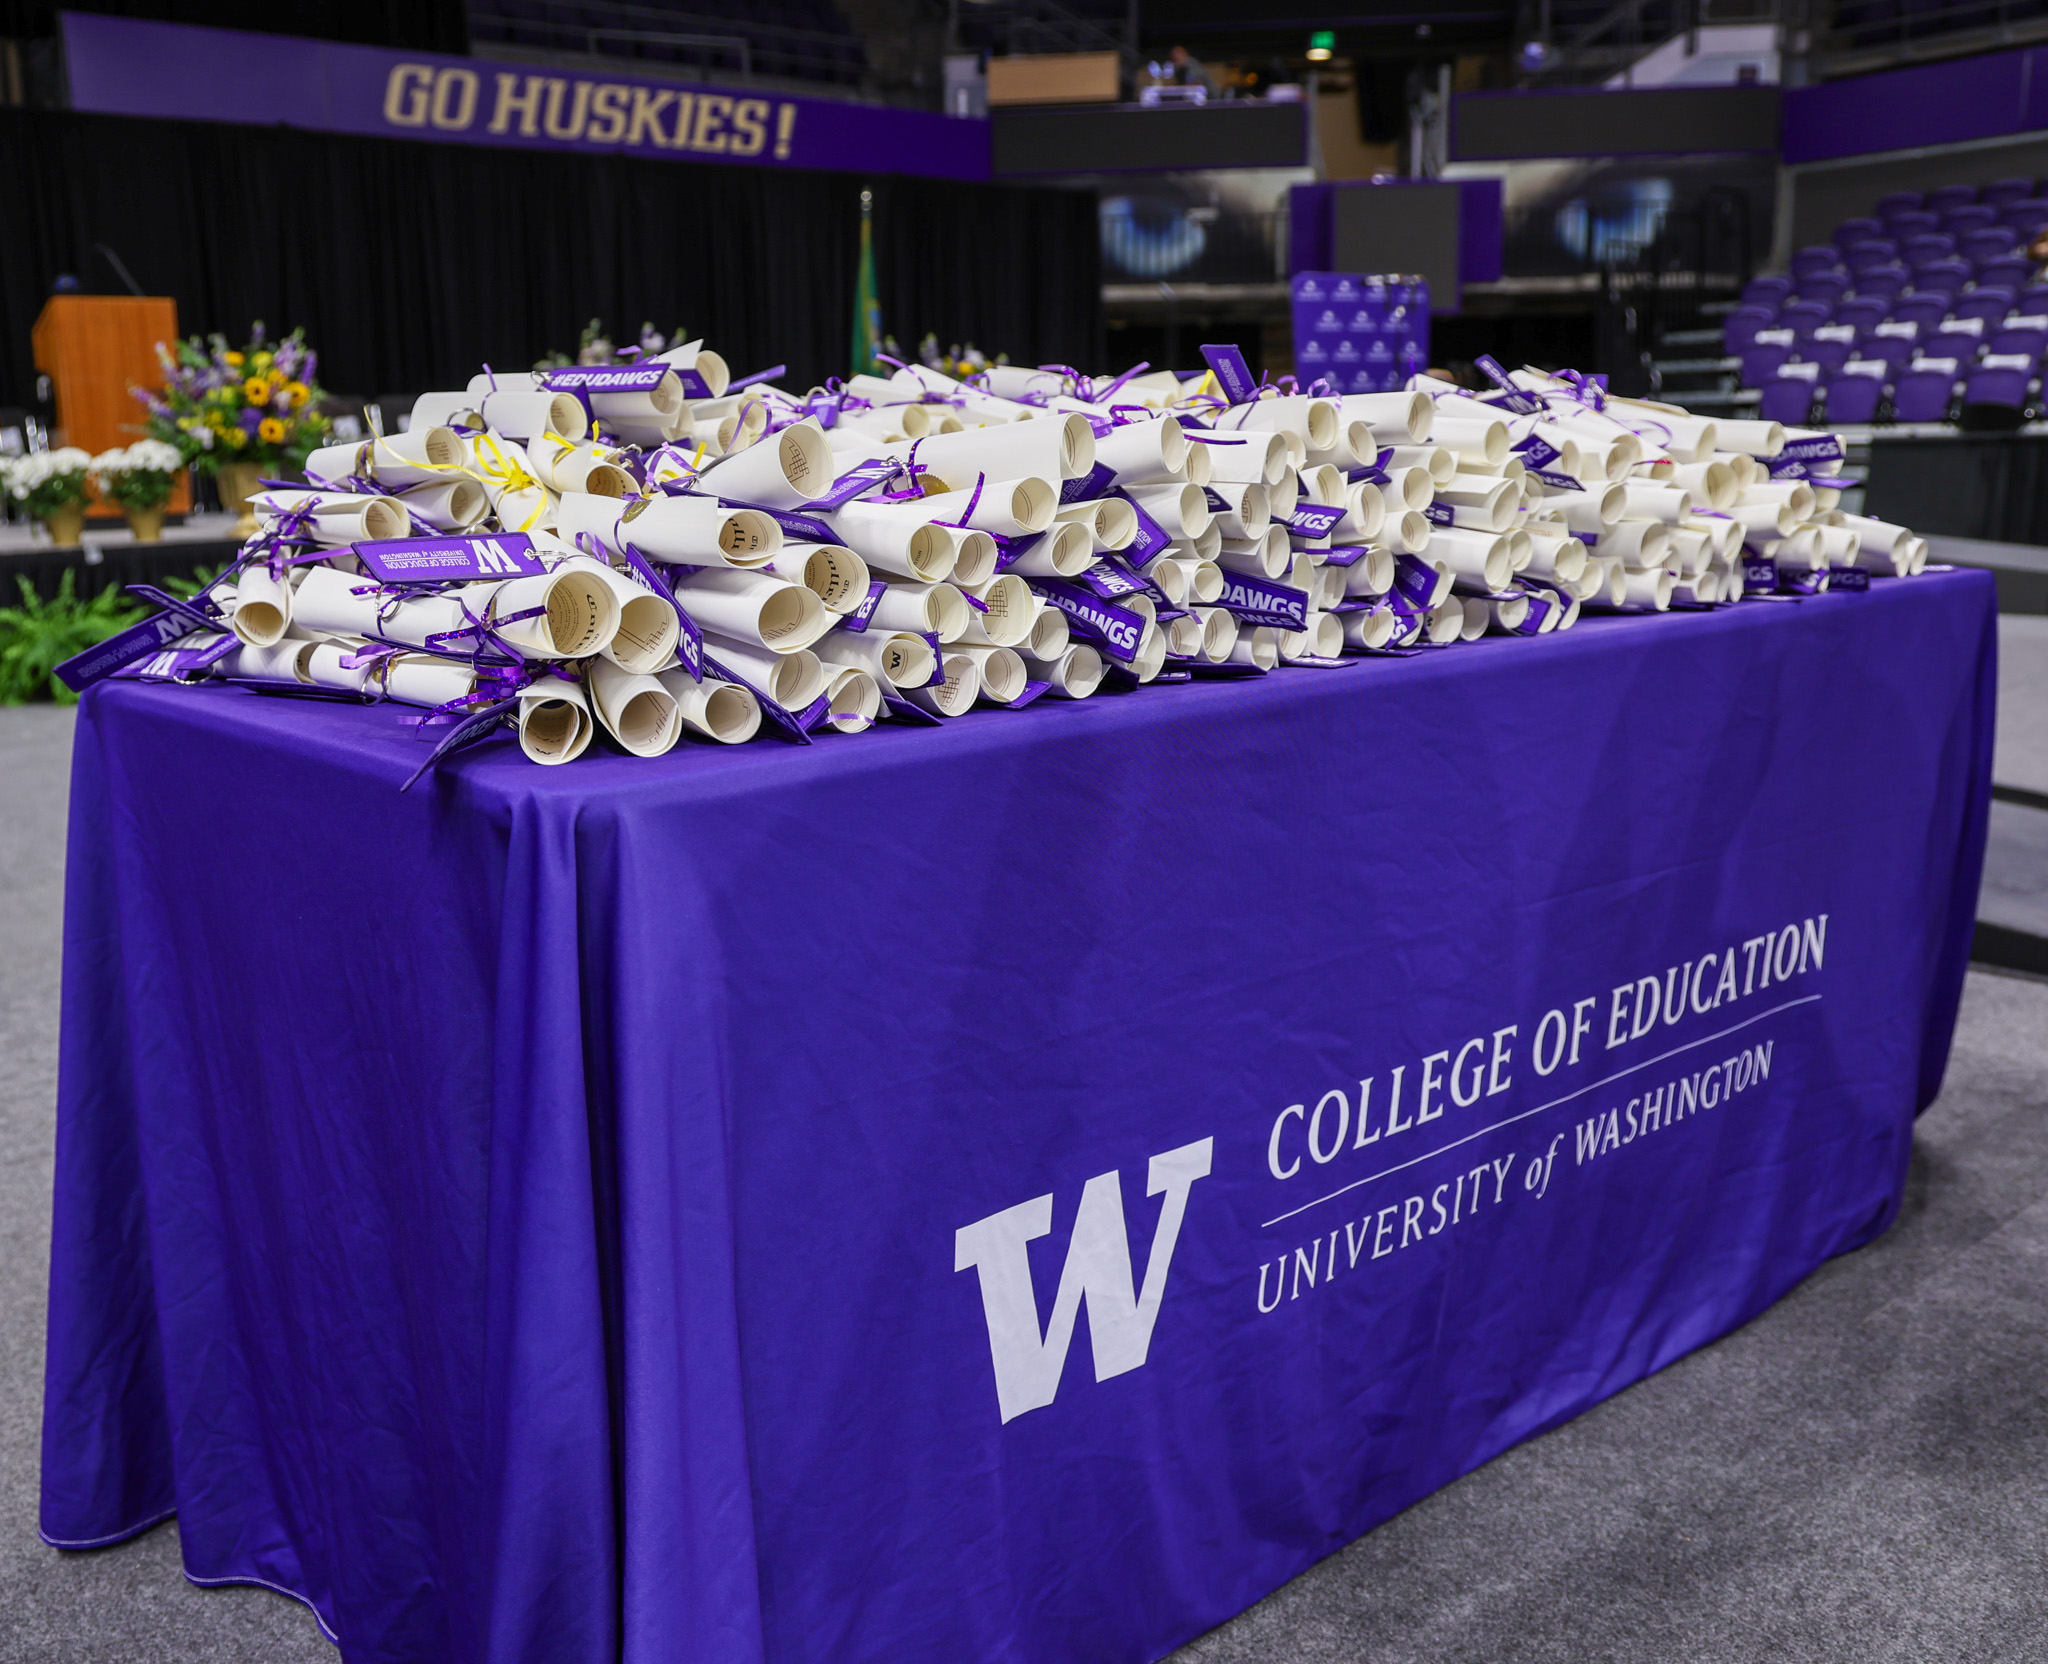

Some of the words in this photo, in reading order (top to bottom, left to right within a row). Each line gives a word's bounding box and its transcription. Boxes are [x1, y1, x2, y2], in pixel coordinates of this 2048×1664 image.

[383, 62, 480, 131] GO
[487, 72, 797, 161] HUSKIES!
[551, 370, 663, 387] #EDUDAWGS
[378, 552, 422, 560] WASHINGTON
[430, 549, 465, 557] UNIVERSITY
[471, 539, 522, 574] W
[384, 559, 429, 569] EDUCATION
[429, 559, 439, 567] OF
[439, 558, 470, 567] COLLEGE
[1268, 1025, 1517, 1180] COLLEGE
[1533, 997, 1596, 1076] OF
[1606, 914, 1829, 1050] EDUCATION
[1257, 1153, 1516, 1314] UNIVERSITY
[1524, 1134, 1565, 1200] of
[1576, 1040, 1774, 1166] WASHINGTON
[954, 1136, 1214, 1426] W
